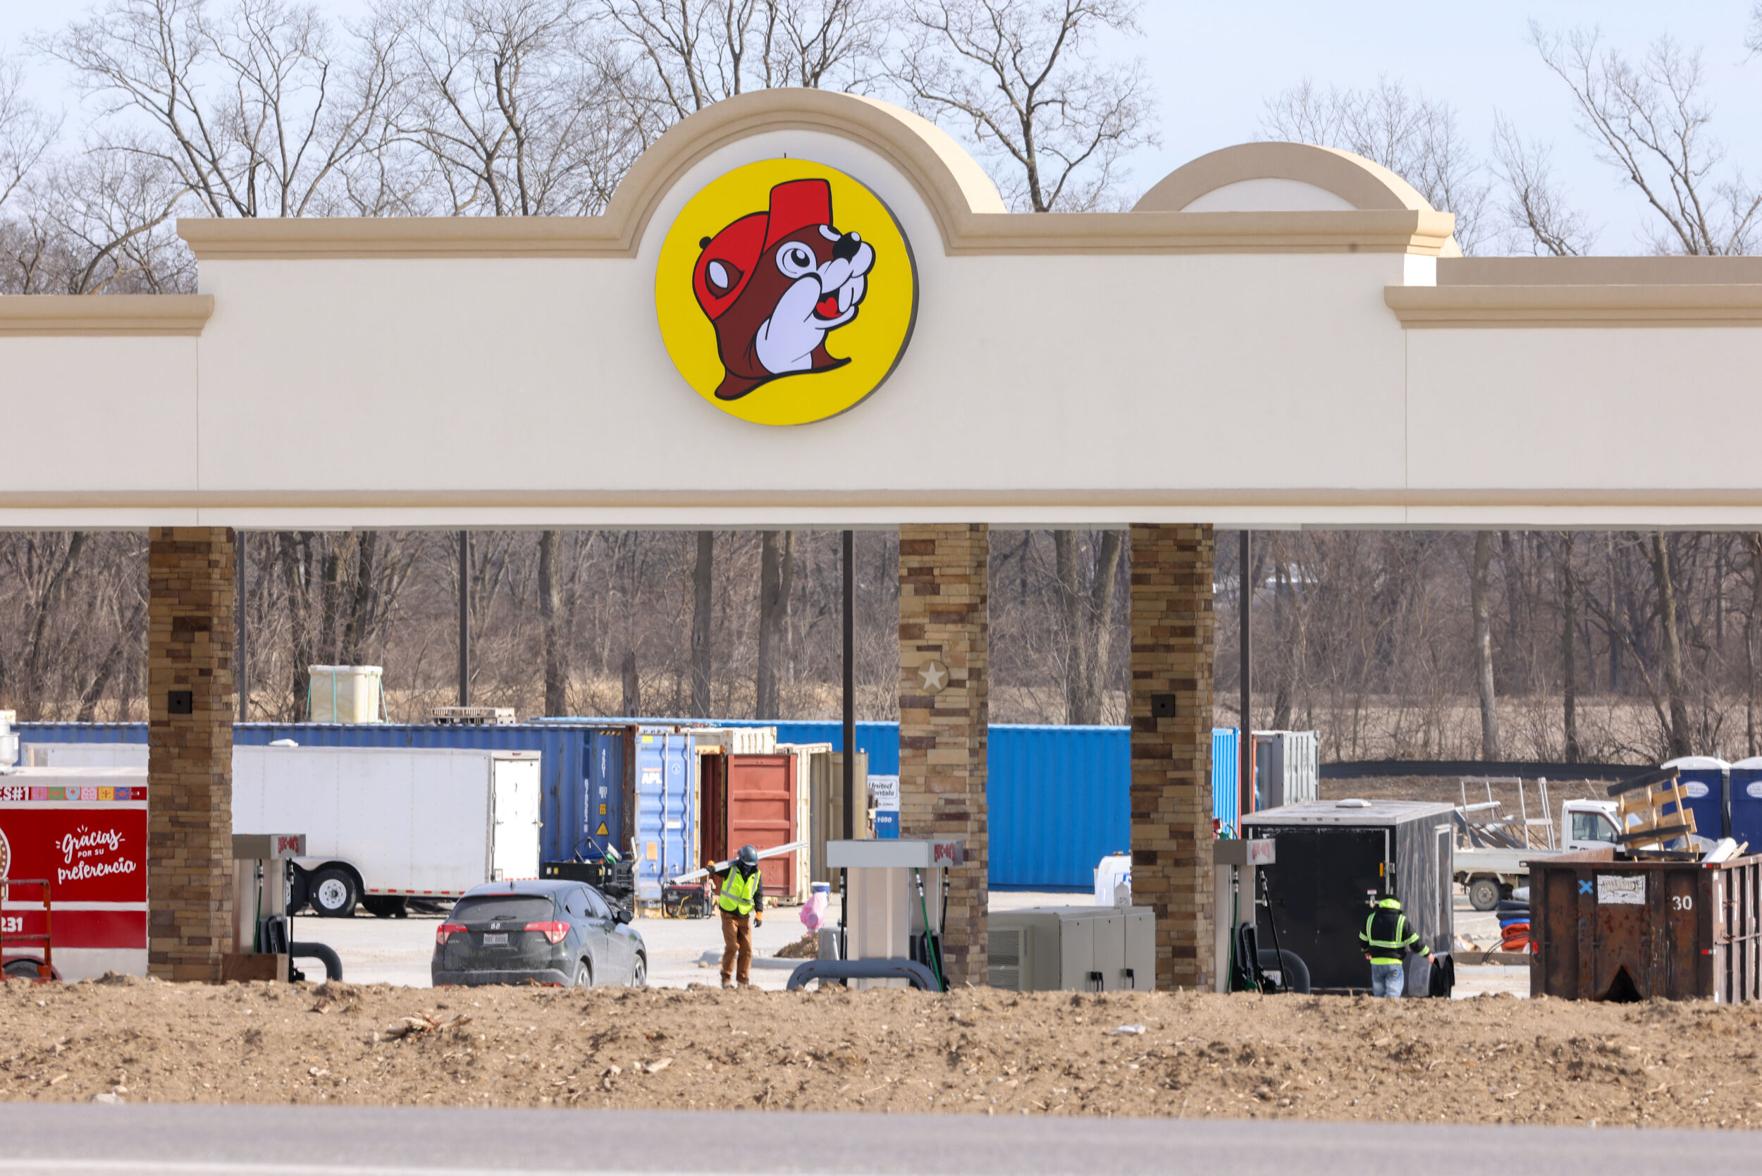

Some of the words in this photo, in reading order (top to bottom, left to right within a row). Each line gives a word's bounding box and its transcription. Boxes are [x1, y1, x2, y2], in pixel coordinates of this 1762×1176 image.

[641, 772, 662, 785] APL
[0, 786, 29, 801] S#1
[62, 828, 122, 864] Gracias
[77, 849, 92, 859] POR
[94, 848, 105, 856] SU
[57, 856, 137, 885] preferencia
[1672, 895, 1693, 911] 30
